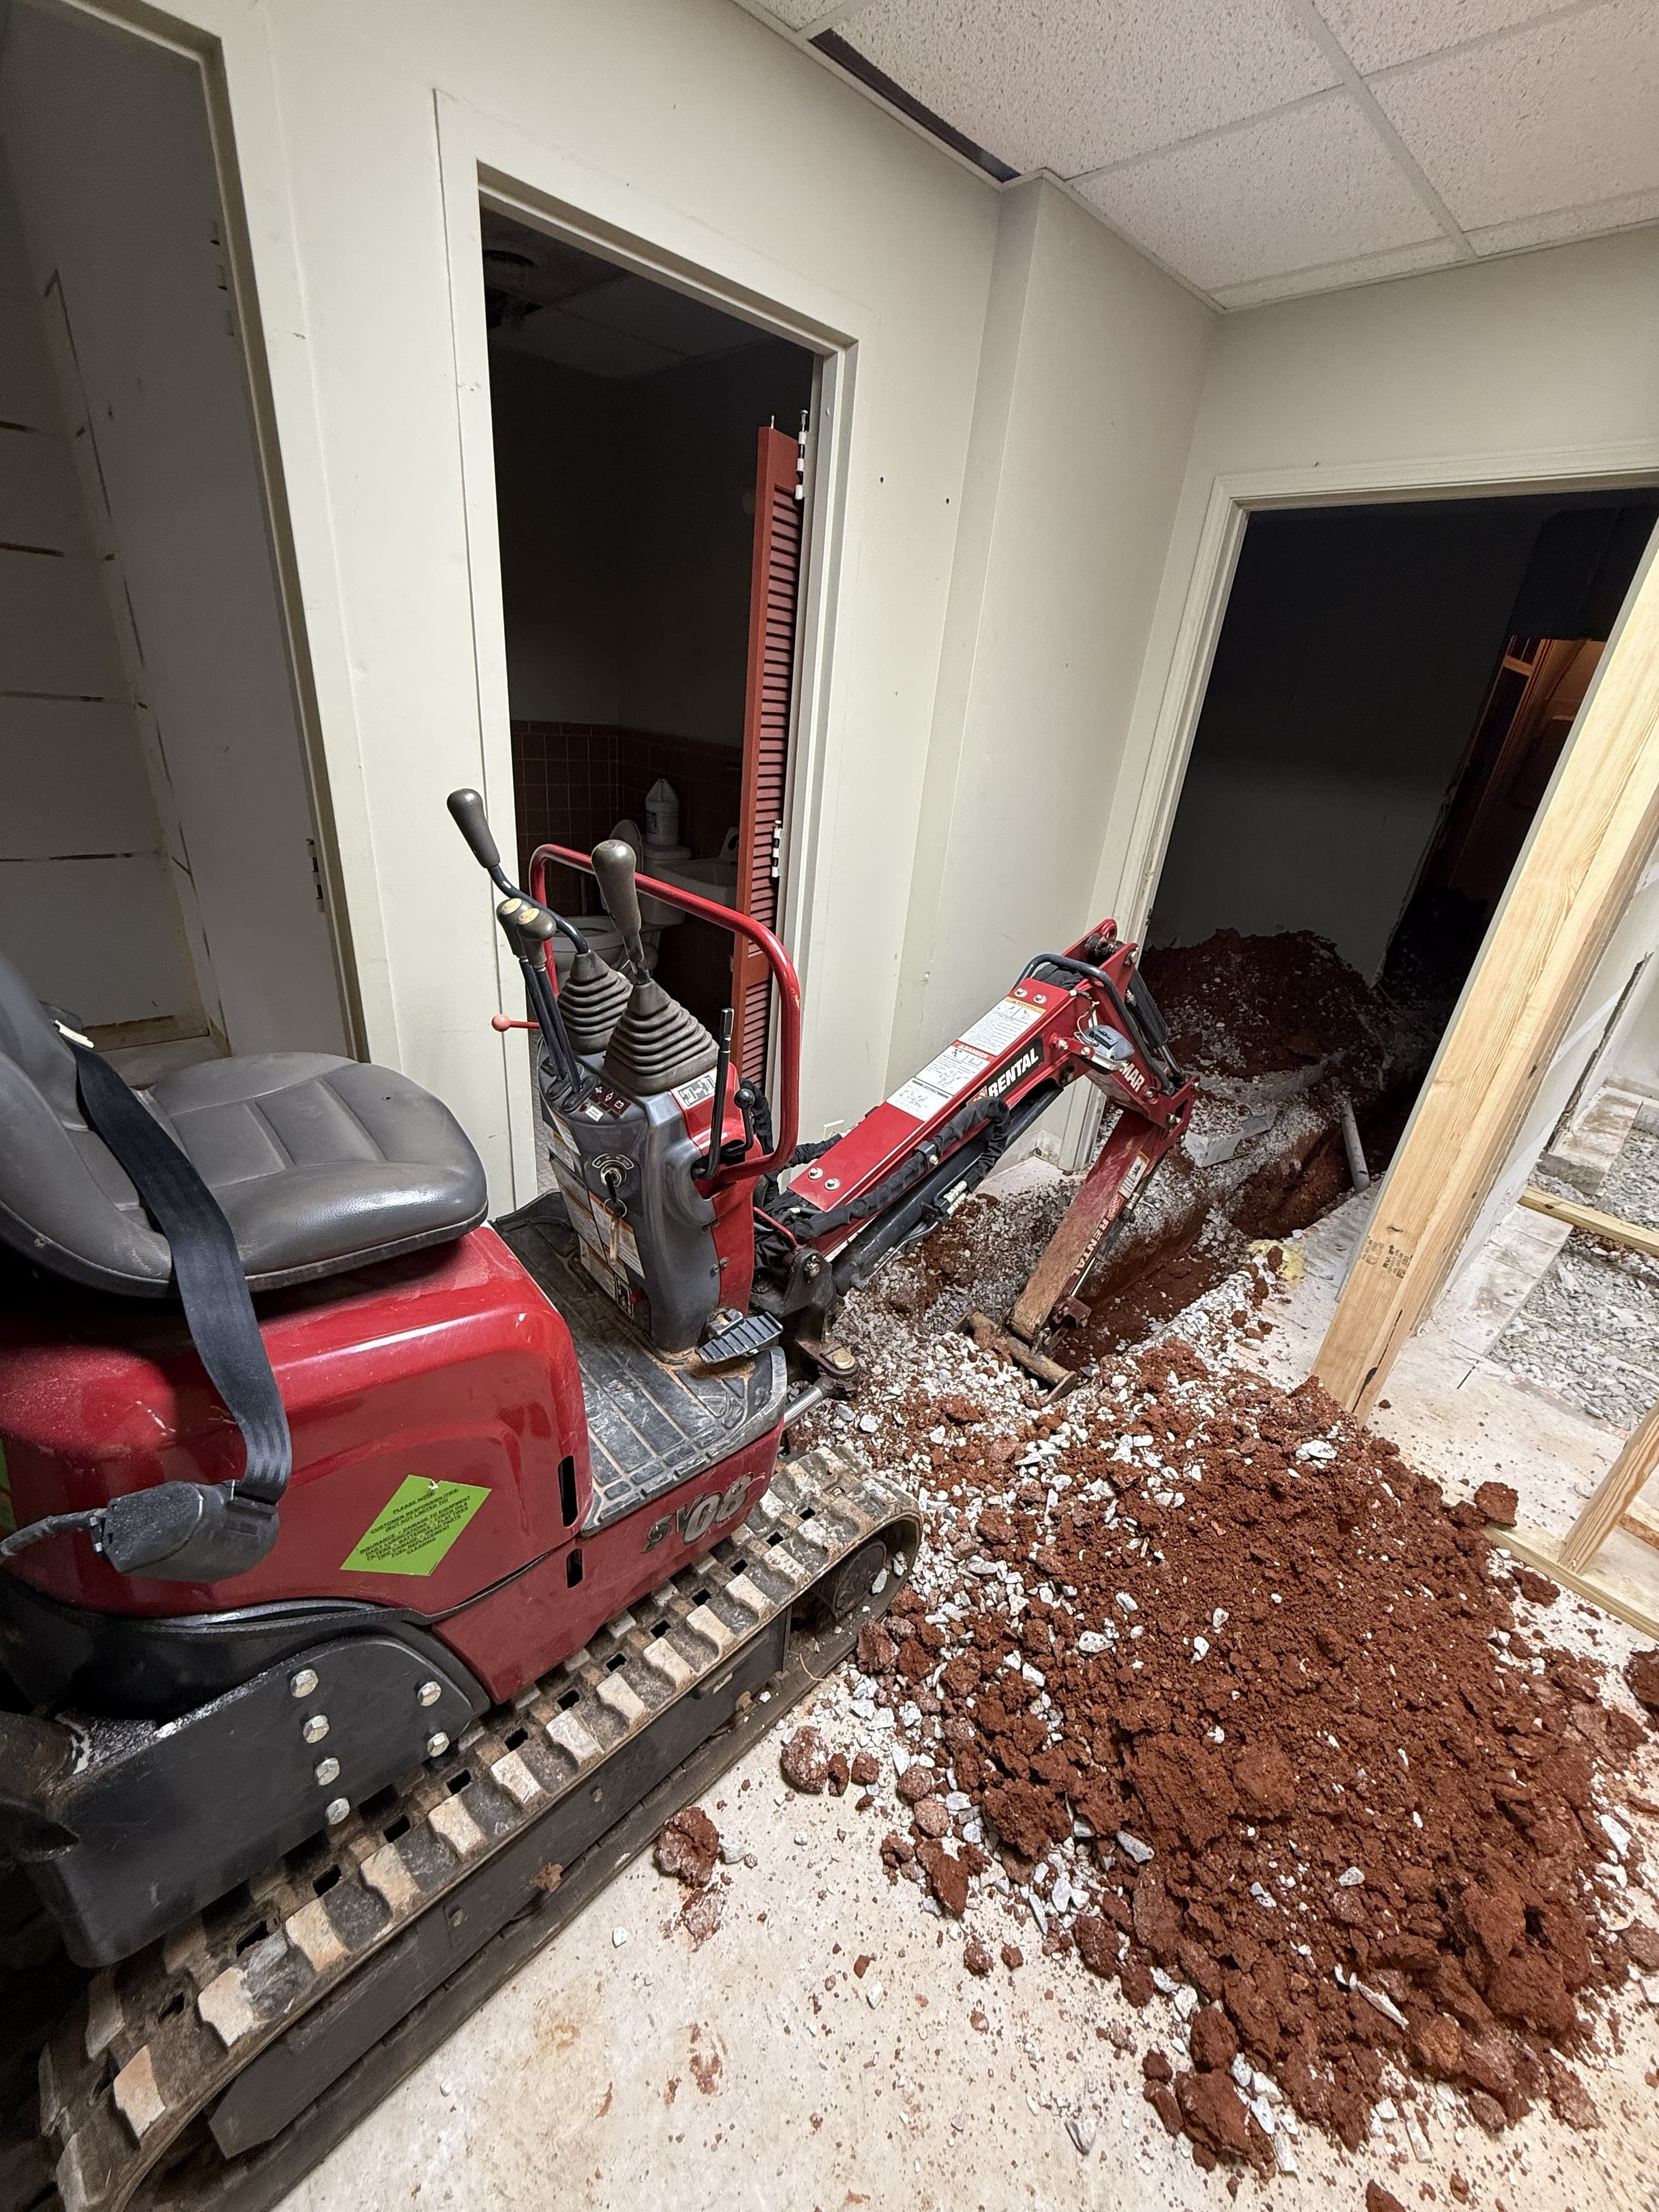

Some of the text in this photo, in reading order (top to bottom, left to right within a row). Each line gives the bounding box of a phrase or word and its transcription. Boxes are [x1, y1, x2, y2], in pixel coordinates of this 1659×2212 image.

[988, 1048, 1039, 1097] RENTAL
[1119, 1063, 1145, 1092] MAR
[1071, 1218, 1109, 1277] RENTAL
[386, 1522, 401, 1532] (BUT
[401, 1515, 413, 1524] NOT
[414, 1504, 437, 1518] LIMITED
[393, 1500, 417, 1514] PLEASE
[360, 1533, 394, 1554] INSURANCE
[403, 1517, 428, 1532] DAMAGE
[438, 1495, 470, 1514] EQUIPMENT
[366, 1502, 467, 1556] DAILY LUBRICATIONS CHECK OILS
[367, 1506, 469, 1561] FILTERS BATTERIES FLAT TIRES
[371, 1515, 405, 1534] CUSTOMER
[392, 1538, 417, 1551] DAMAGE
[425, 1523, 442, 1536] WEAR
[443, 1515, 461, 1525] PARTS
[392, 1525, 449, 1558] FUEL REPLACEMENT
[407, 1537, 436, 1554] CLEANING
